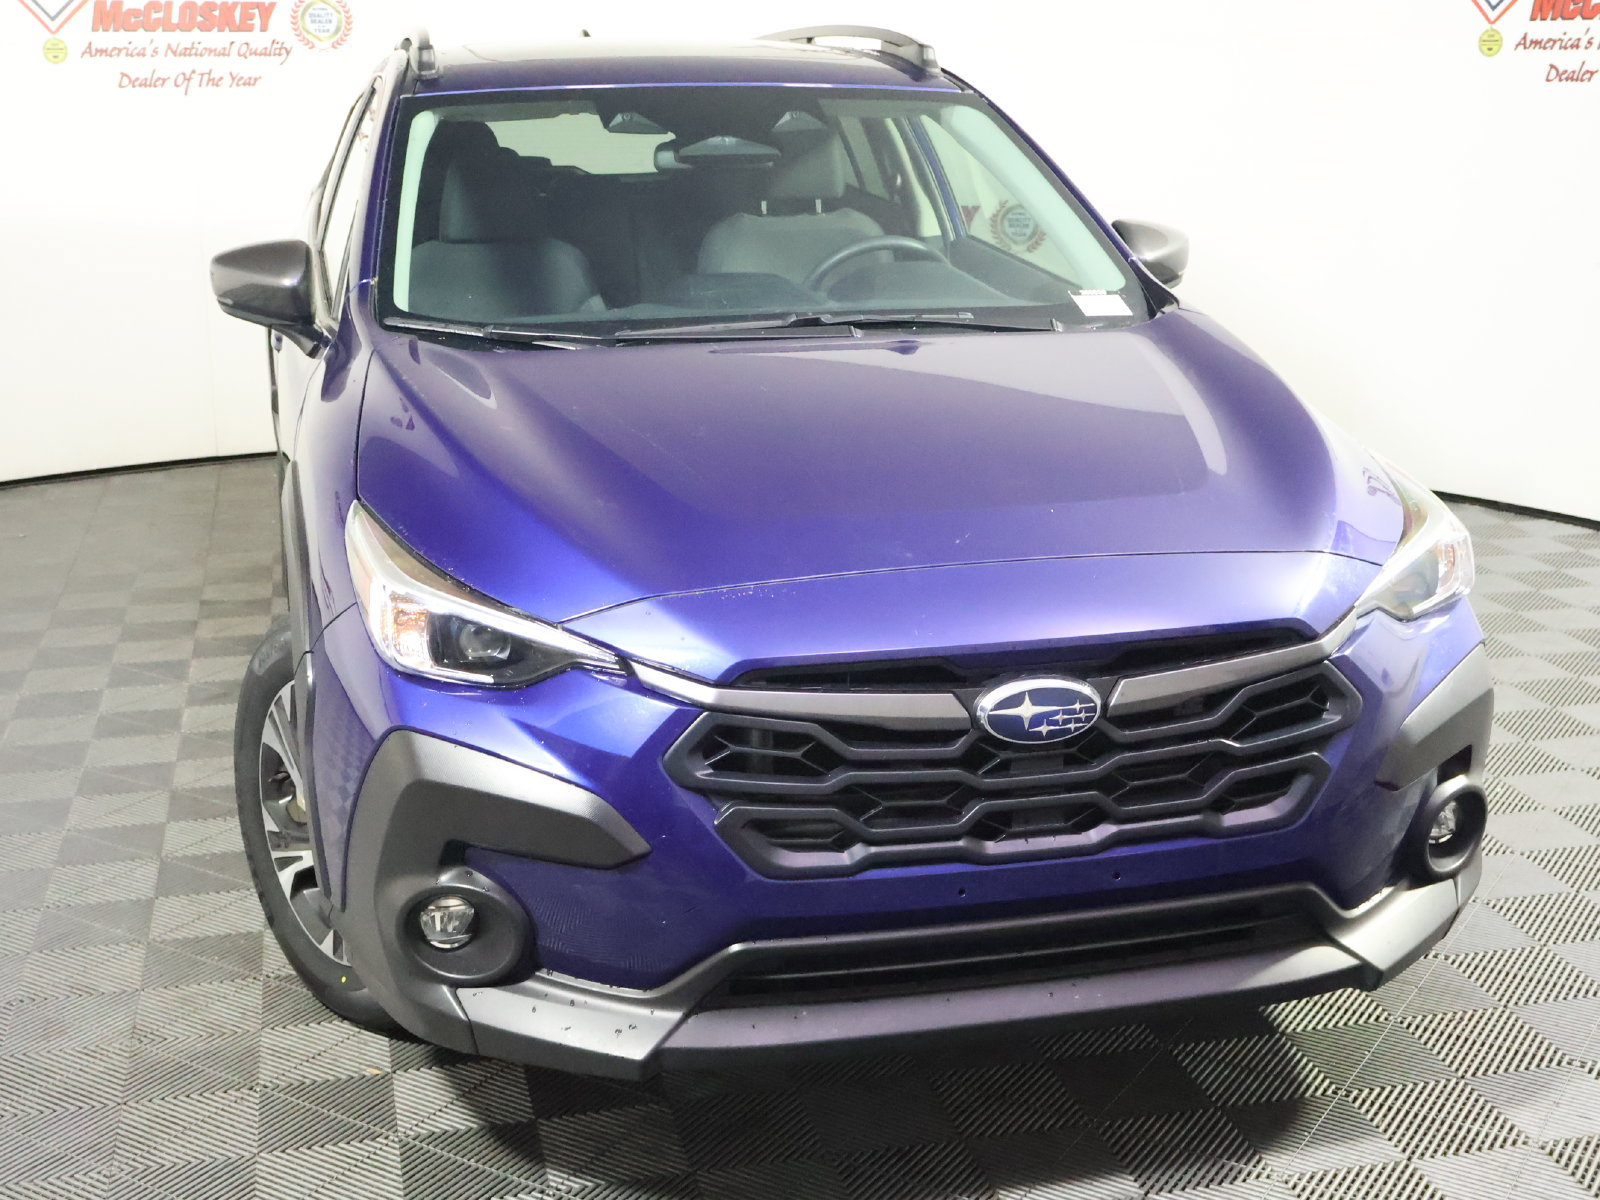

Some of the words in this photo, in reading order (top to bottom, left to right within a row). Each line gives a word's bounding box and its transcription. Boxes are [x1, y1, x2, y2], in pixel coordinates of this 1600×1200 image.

[92, 0, 277, 32] McCLOSKEY
[80, 38, 159, 58] America's
[164, 41, 235, 57] National
[237, 38, 293, 65] Quality
[1514, 27, 1594, 51] America's
[118, 68, 170, 88] Dealer
[174, 68, 196, 96] Of
[197, 69, 224, 87] The
[228, 71, 262, 88] Year
[1545, 60, 1599, 83] Dealer
